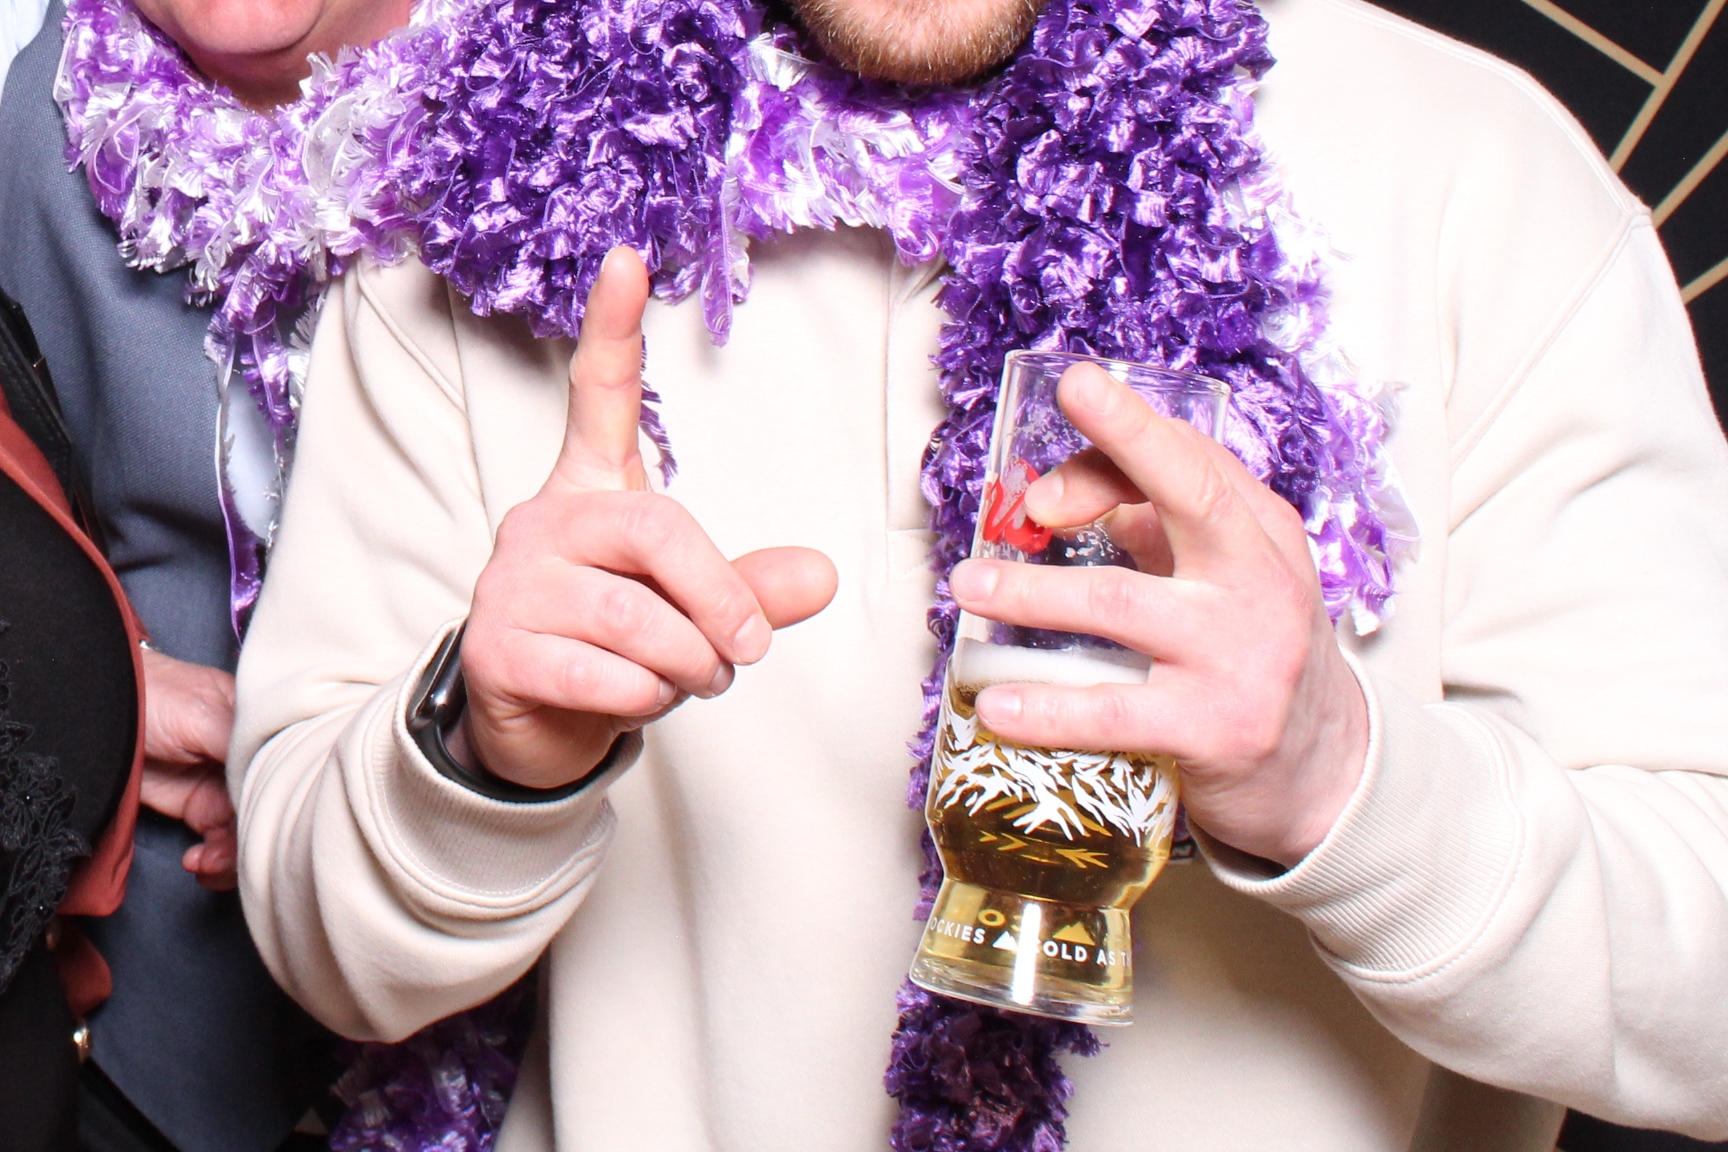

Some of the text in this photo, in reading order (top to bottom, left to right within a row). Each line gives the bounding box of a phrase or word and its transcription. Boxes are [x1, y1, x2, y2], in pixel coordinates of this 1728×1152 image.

[930, 916, 986, 945] OCKIES
[1038, 938, 1088, 963] OLD
[1096, 949, 1116, 966] AS
